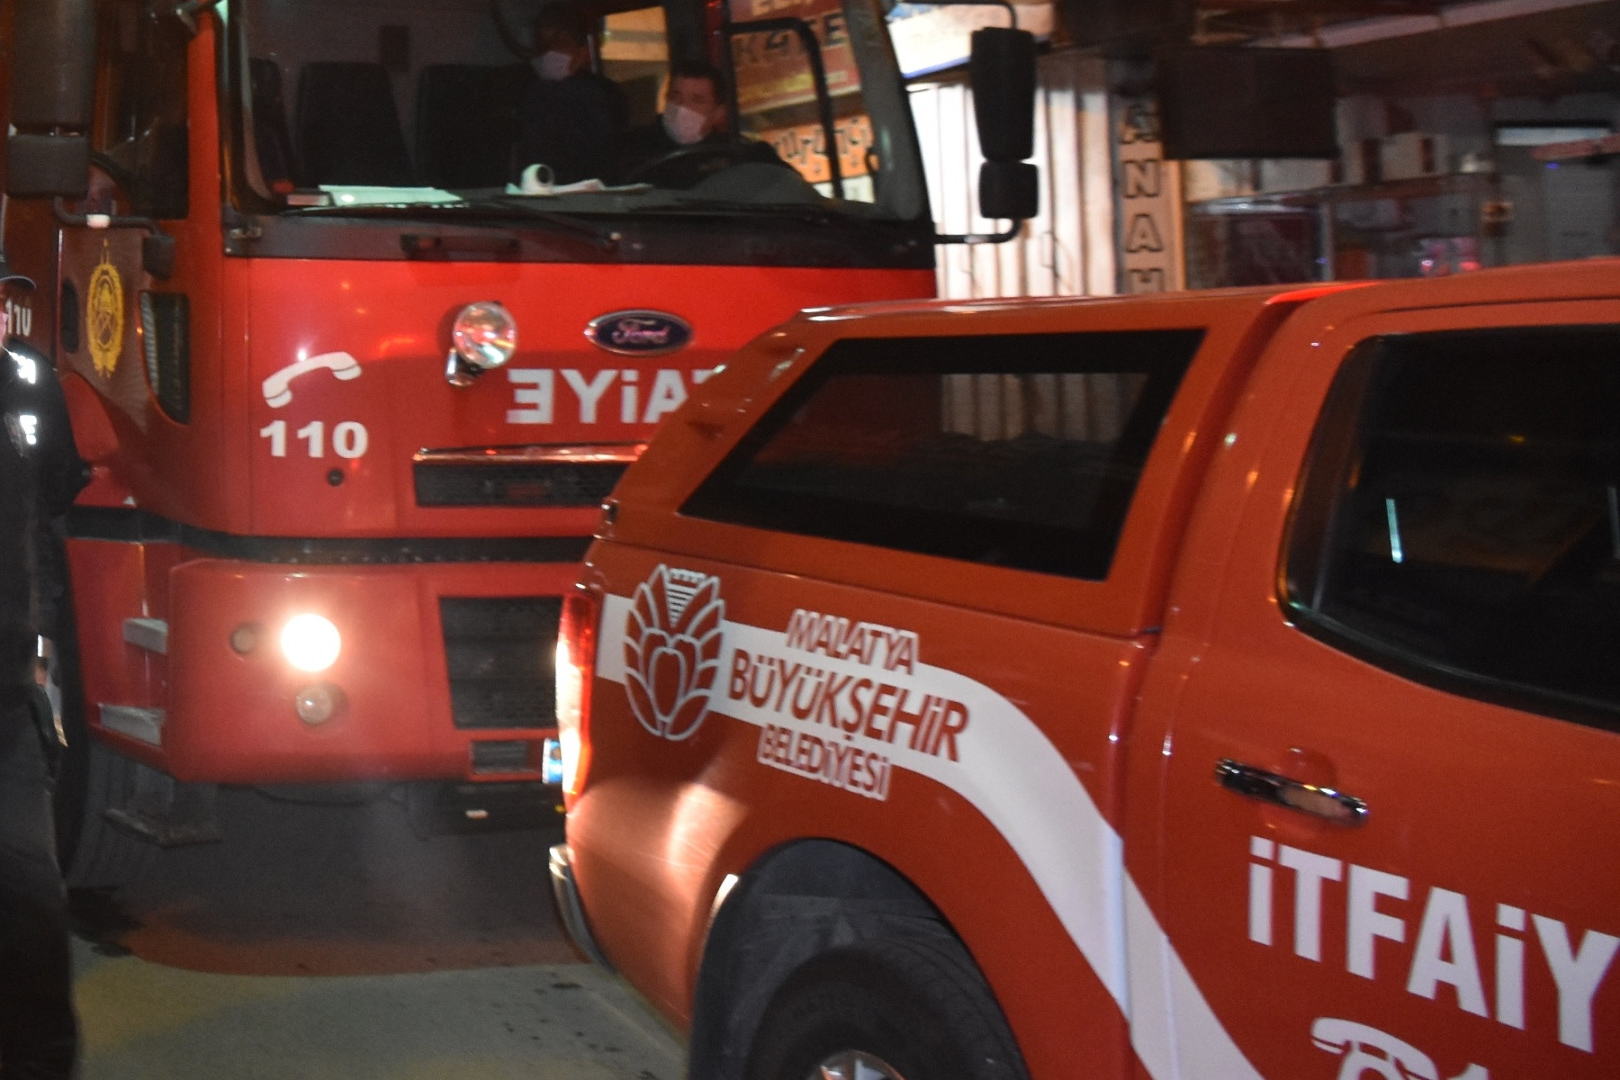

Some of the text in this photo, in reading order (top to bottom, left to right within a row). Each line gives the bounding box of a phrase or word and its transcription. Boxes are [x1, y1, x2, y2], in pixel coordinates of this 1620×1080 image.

[259, 420, 368, 459] 110
[786, 608, 918, 677] MALATYA
[730, 646, 969, 763] BÜYÜKŞEHİR
[756, 724, 891, 801] BELEDİYESİ
